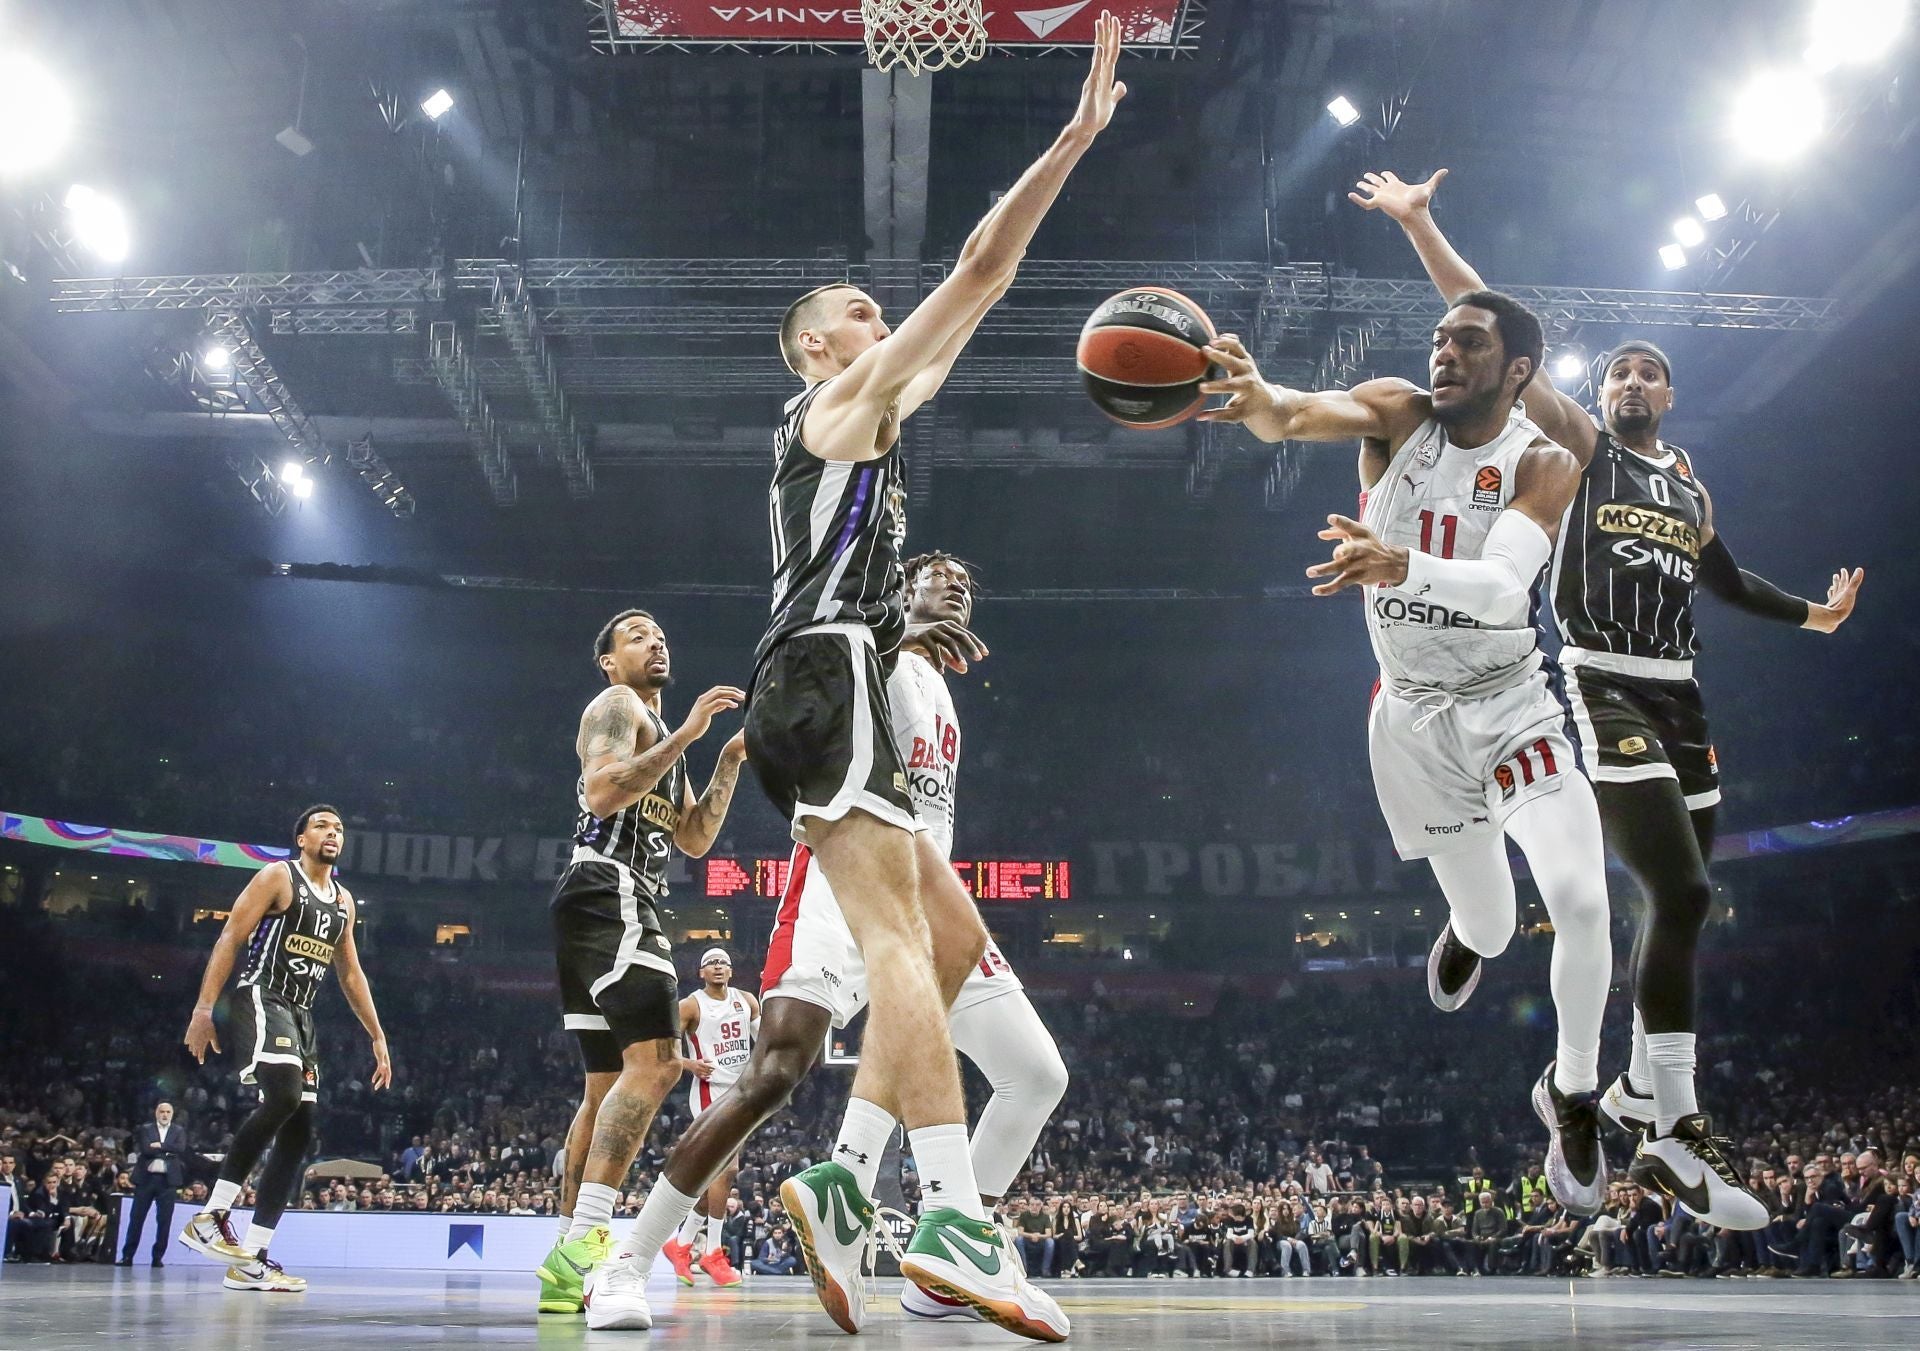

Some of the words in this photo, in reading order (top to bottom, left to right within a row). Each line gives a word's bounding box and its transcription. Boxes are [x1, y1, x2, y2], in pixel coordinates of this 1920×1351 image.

[709, 6, 864, 23] BANKA
[1649, 474, 1670, 506] 0
[1418, 509, 1457, 560] 11
[1653, 548, 1694, 583] NIS
[1515, 737, 1560, 786] 11
[314, 909, 331, 940] 12
[721, 1021, 741, 1040] 95
